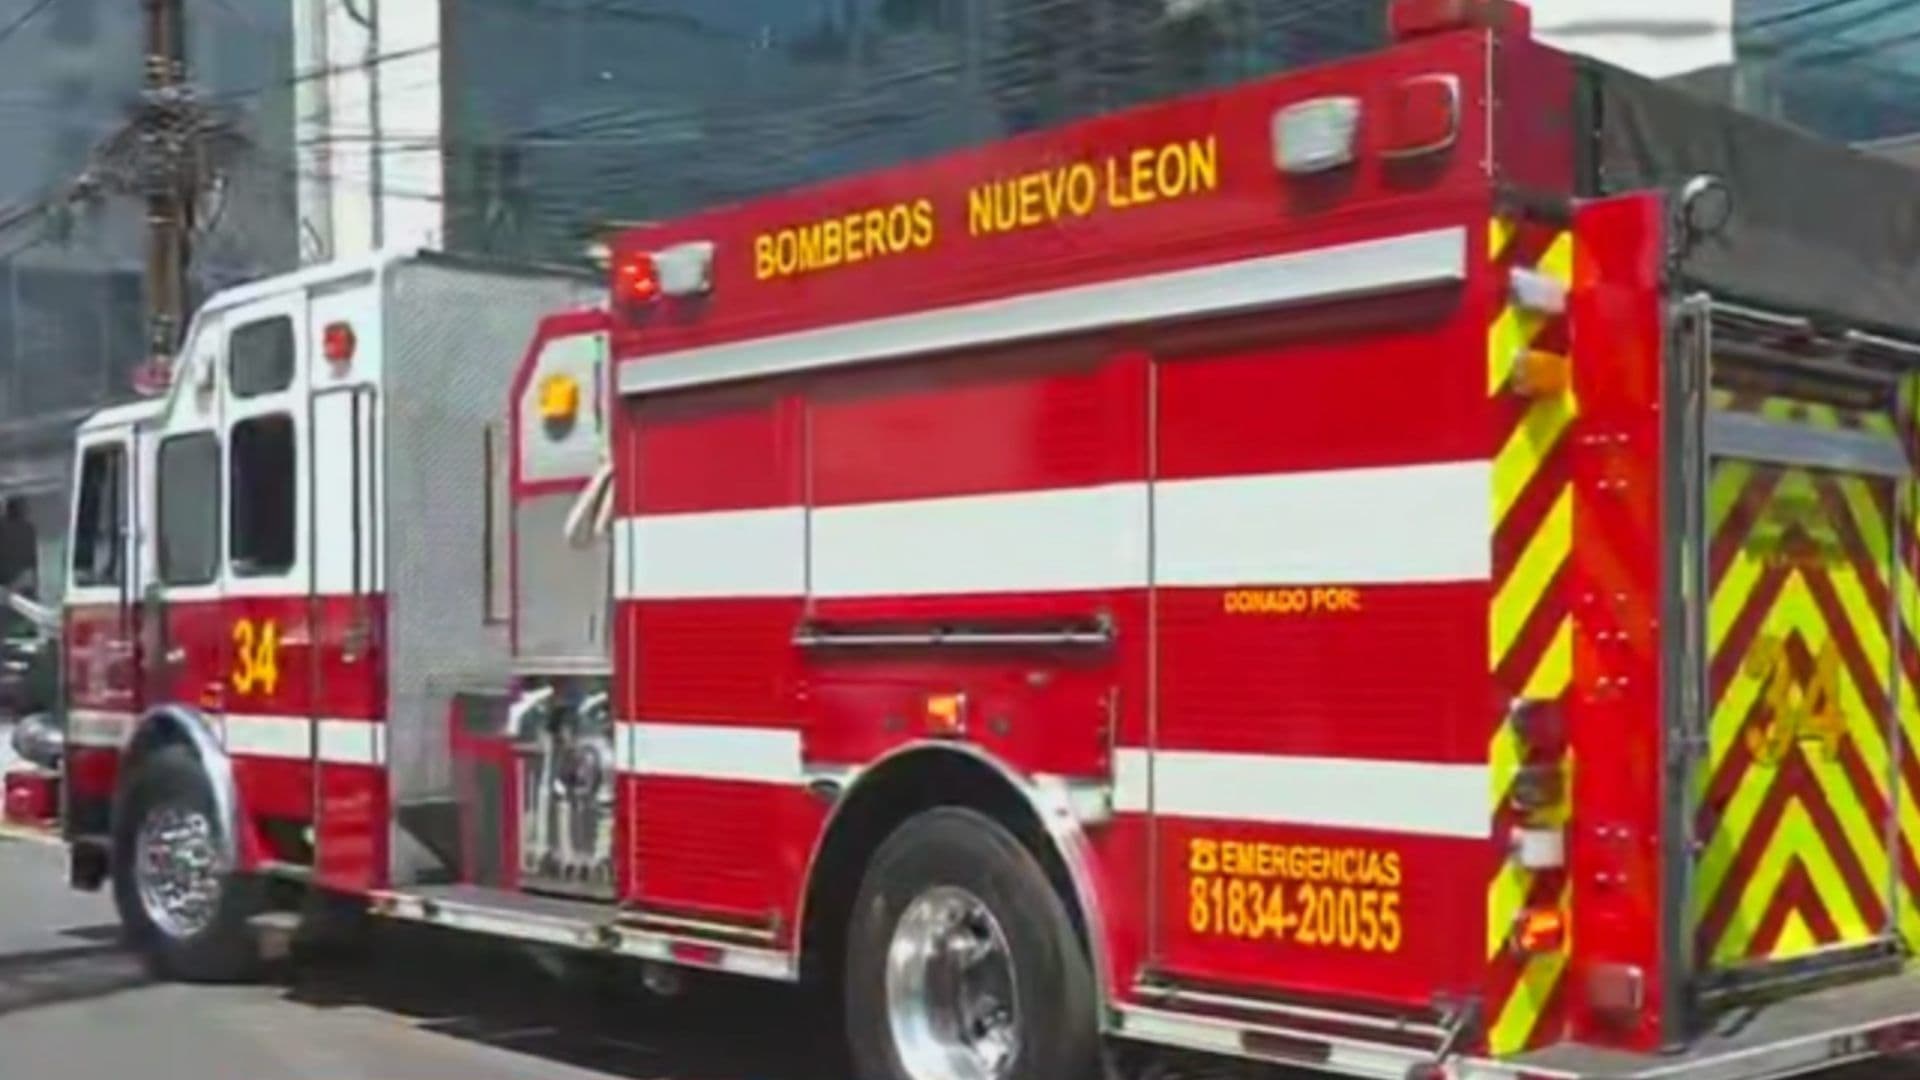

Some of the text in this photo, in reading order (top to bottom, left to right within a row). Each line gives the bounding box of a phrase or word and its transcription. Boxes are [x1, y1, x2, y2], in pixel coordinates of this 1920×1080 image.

[755, 136, 1218, 280] BOMBEROS NUEVO LEON
[1224, 590, 1307, 613] DONADO
[232, 619, 278, 694] 34
[1221, 840, 1400, 886] EMERGENCIAS
[1190, 876, 1401, 952] 81834-20055
